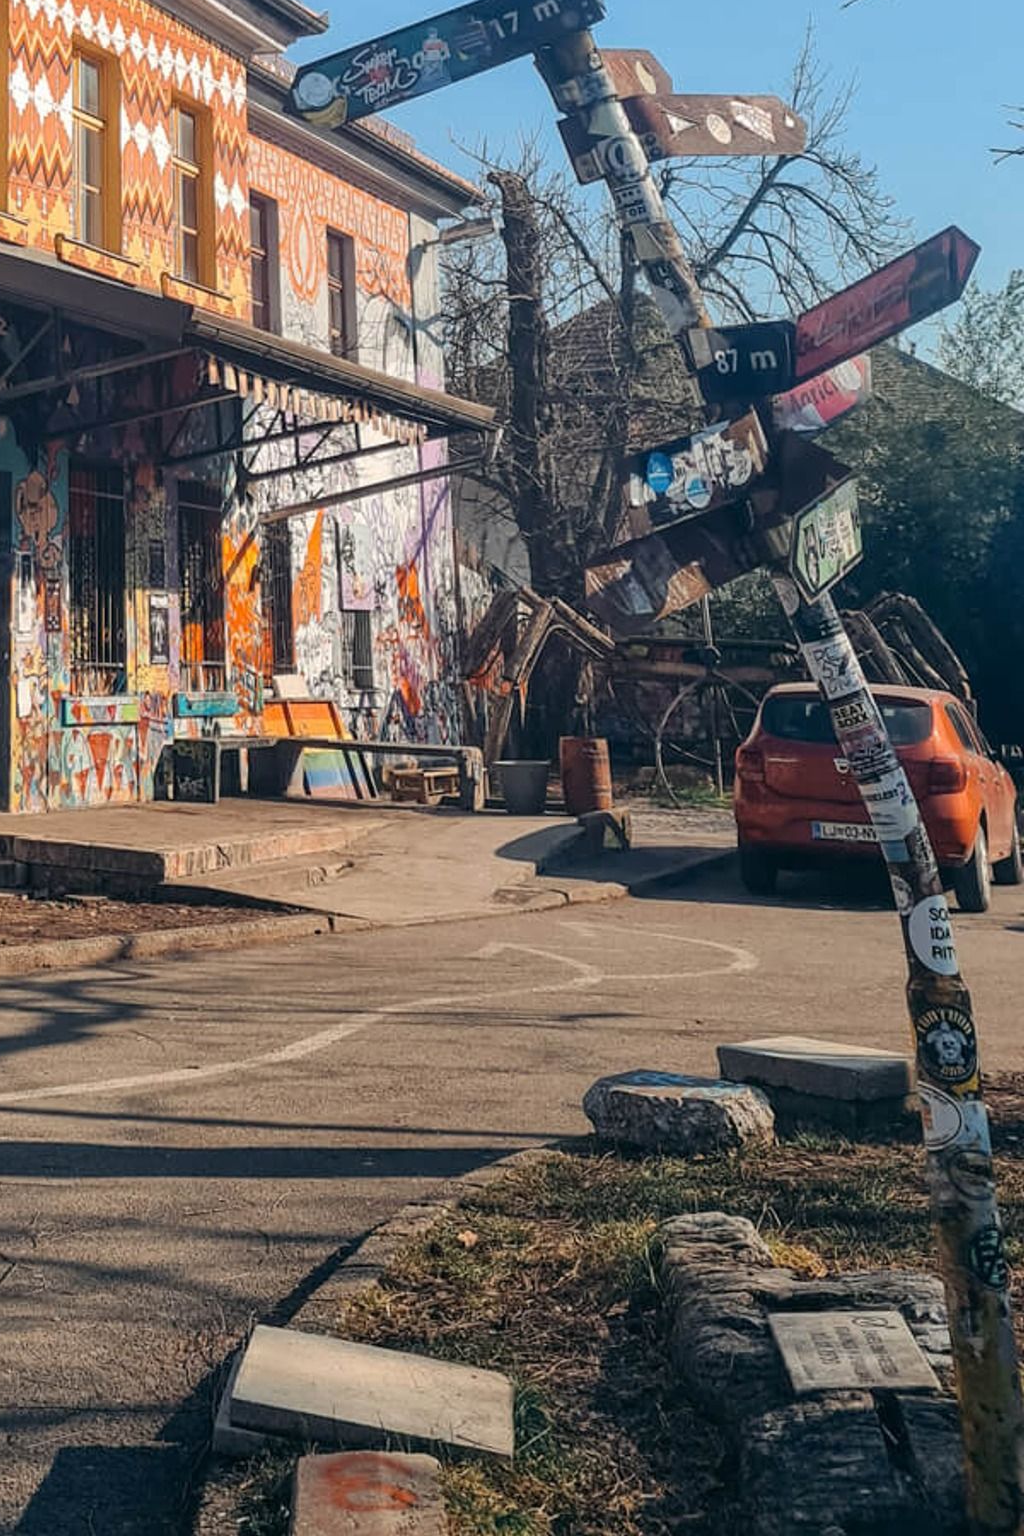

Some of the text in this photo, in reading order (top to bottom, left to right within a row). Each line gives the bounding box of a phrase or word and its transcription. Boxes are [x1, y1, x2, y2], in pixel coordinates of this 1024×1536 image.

[489, 11, 520, 40] 17
[713, 348, 777, 375] 87 m
[931, 945, 956, 961] RIT
